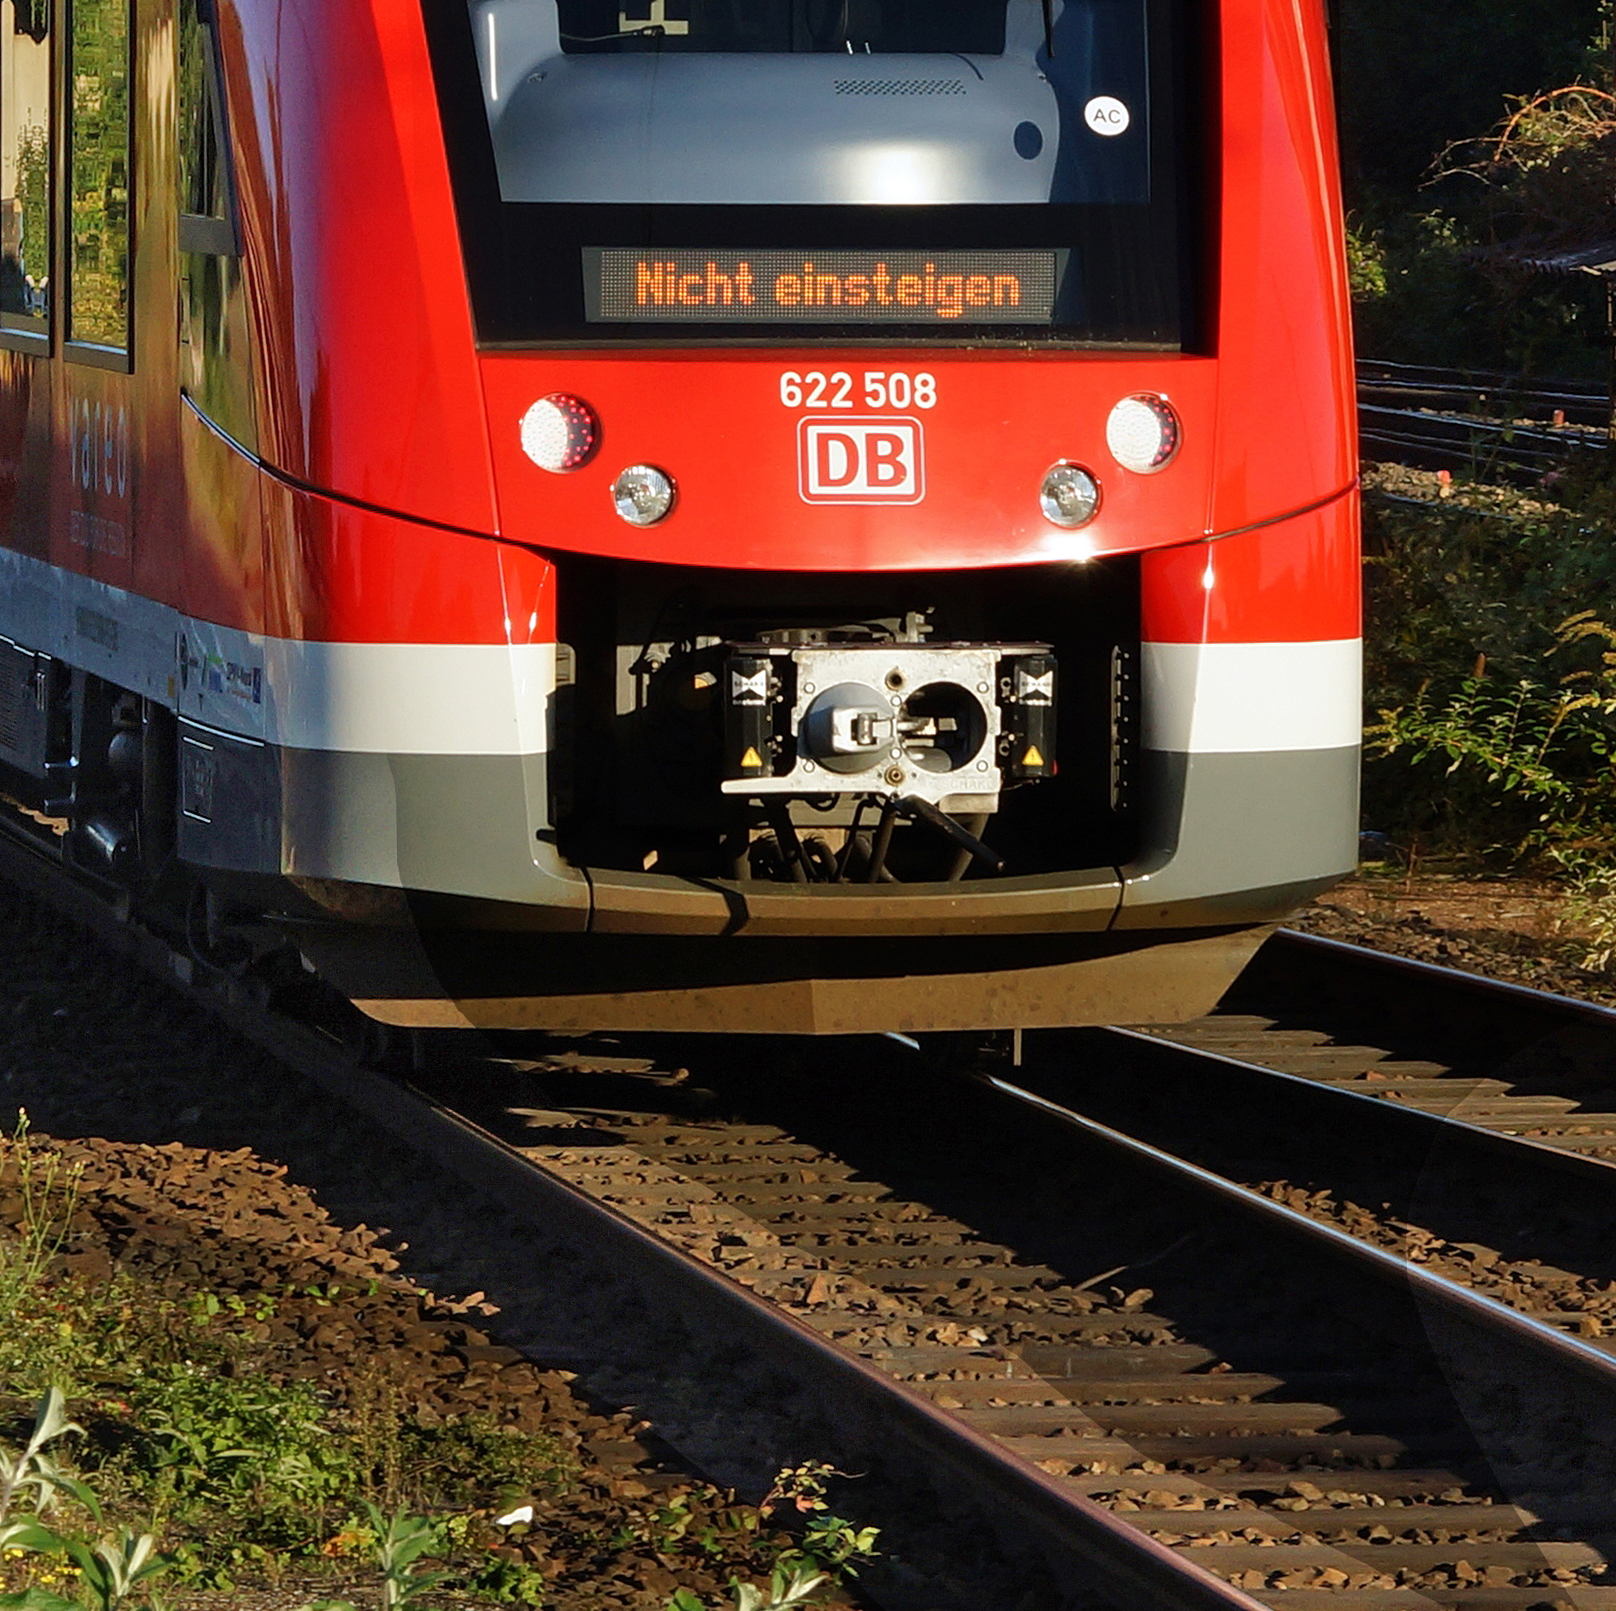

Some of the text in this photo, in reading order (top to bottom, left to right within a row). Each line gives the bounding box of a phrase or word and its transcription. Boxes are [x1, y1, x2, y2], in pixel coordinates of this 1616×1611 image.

[1093, 108, 1122, 124] AC
[636, 261, 1021, 319] Nicht einsteigen
[779, 371, 938, 409] 622 508
[816, 432, 908, 489] DB
